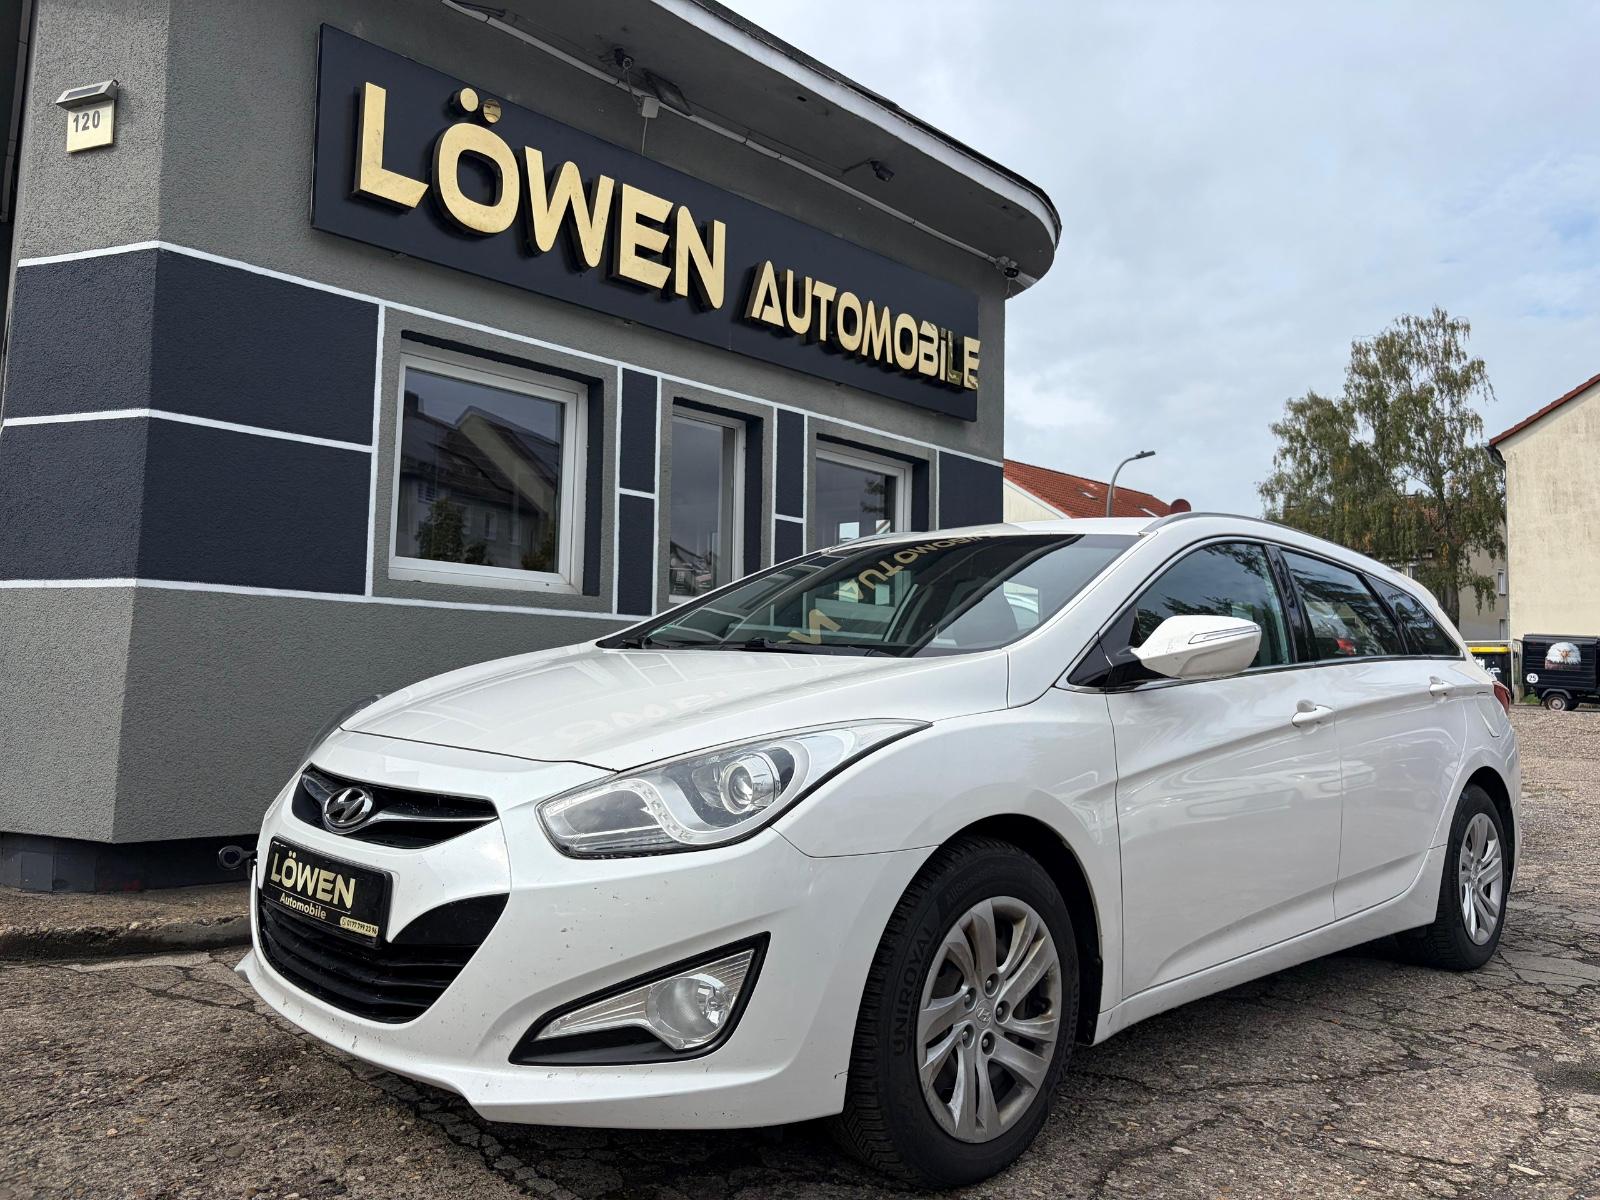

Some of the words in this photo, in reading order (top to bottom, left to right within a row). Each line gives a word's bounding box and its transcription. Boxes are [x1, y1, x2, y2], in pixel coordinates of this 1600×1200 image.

[73, 110, 100, 132] 120
[359, 82, 726, 309] LÖWEN
[271, 851, 356, 908] LÖWEN
[280, 893, 327, 920] Automobile
[894, 927, 937, 1056] UNIROYAL
